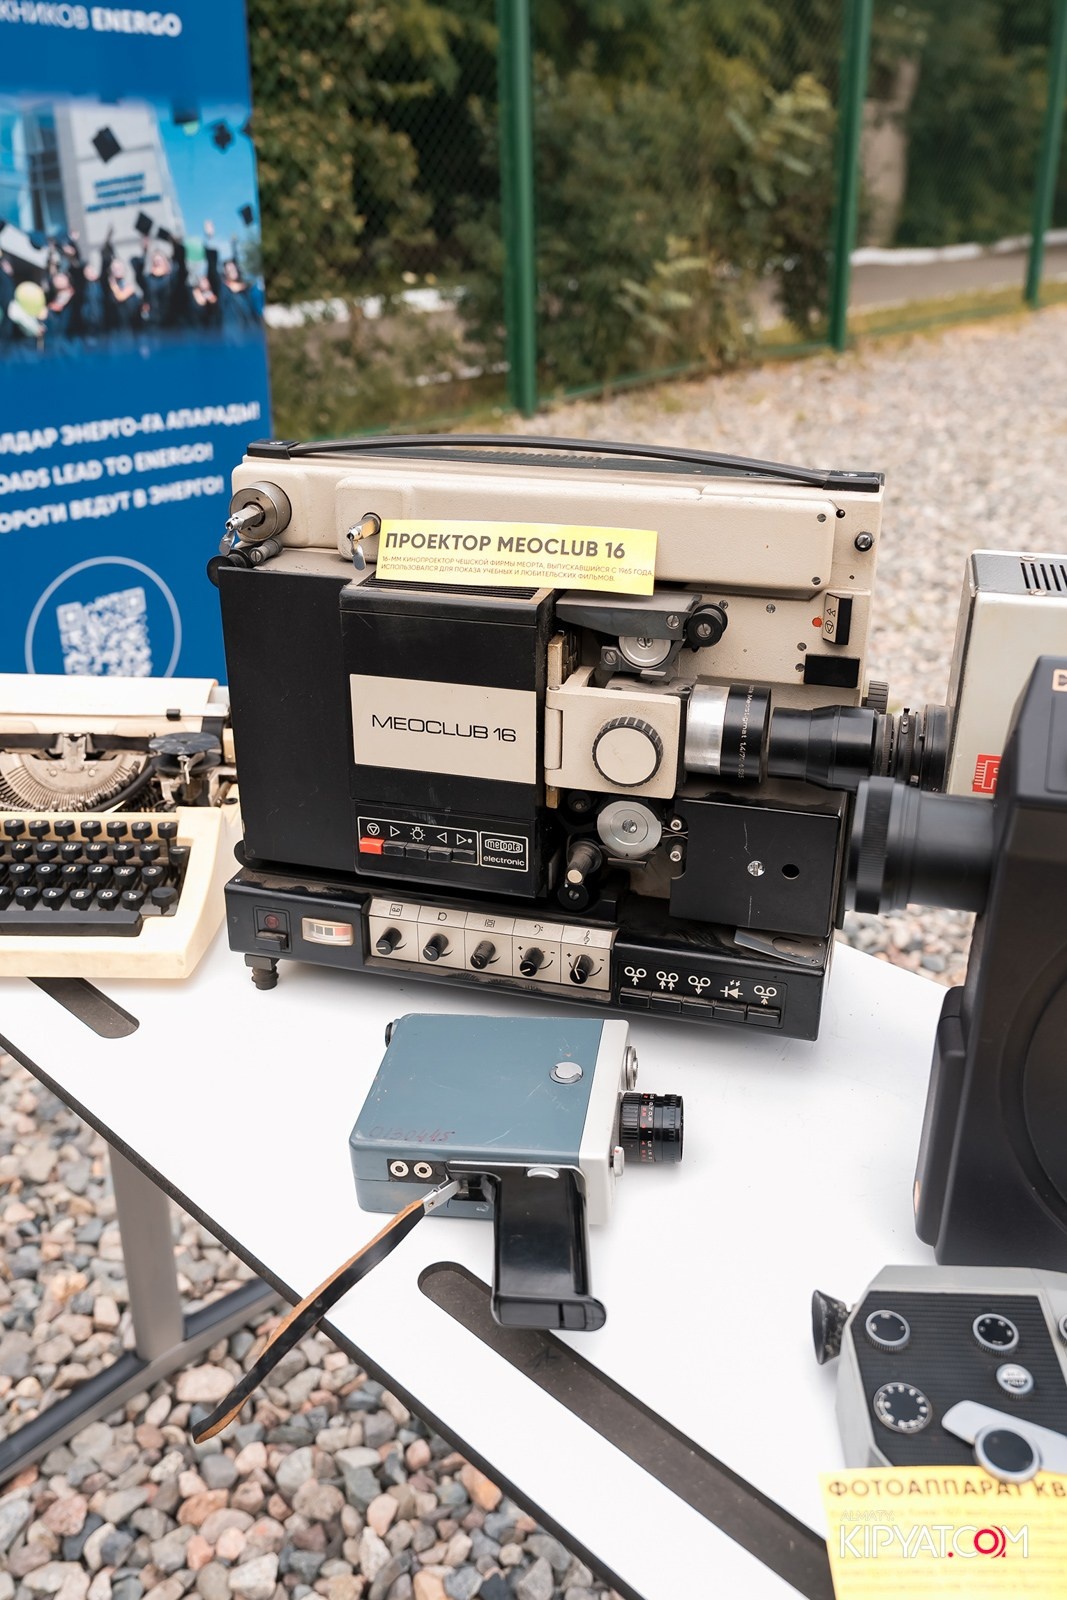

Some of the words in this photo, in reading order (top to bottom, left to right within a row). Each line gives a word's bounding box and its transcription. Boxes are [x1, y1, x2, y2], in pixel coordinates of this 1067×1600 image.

[91, 6, 182, 37] ENERGO
[52, 459, 103, 486] LEAD
[103, 454, 133, 477] TO
[134, 442, 213, 472] ENERGO!
[69, 491, 131, 520] ВЕДУТ
[133, 488, 147, 508] В
[148, 475, 224, 505] ЭНЕРГО!
[385, 533, 492, 551] ПРОЕКТОР
[497, 536, 599, 557] MEOCLUB
[605, 542, 626, 559] 16
[381, 563, 439, 572] ИСПОЛЬЗОВАЛСЯ
[454, 566, 481, 574] ПОКАЗА
[520, 570, 576, 579] ЛЮБИТЕЛЬСКИХ
[403, 557, 455, 565] КИНОПРОЕКТОР
[456, 558, 489, 566] ЧЕШСКОЙ
[547, 562, 610, 574] ВЫПУСКАВШИЙСЯ
[372, 714, 489, 739] MEOCLUB
[493, 727, 517, 742] 16
[485, 839, 523, 853] meopta
[483, 855, 525, 867] electronic
[829, 1478, 1023, 1498] ФОТОАППАРАТ
